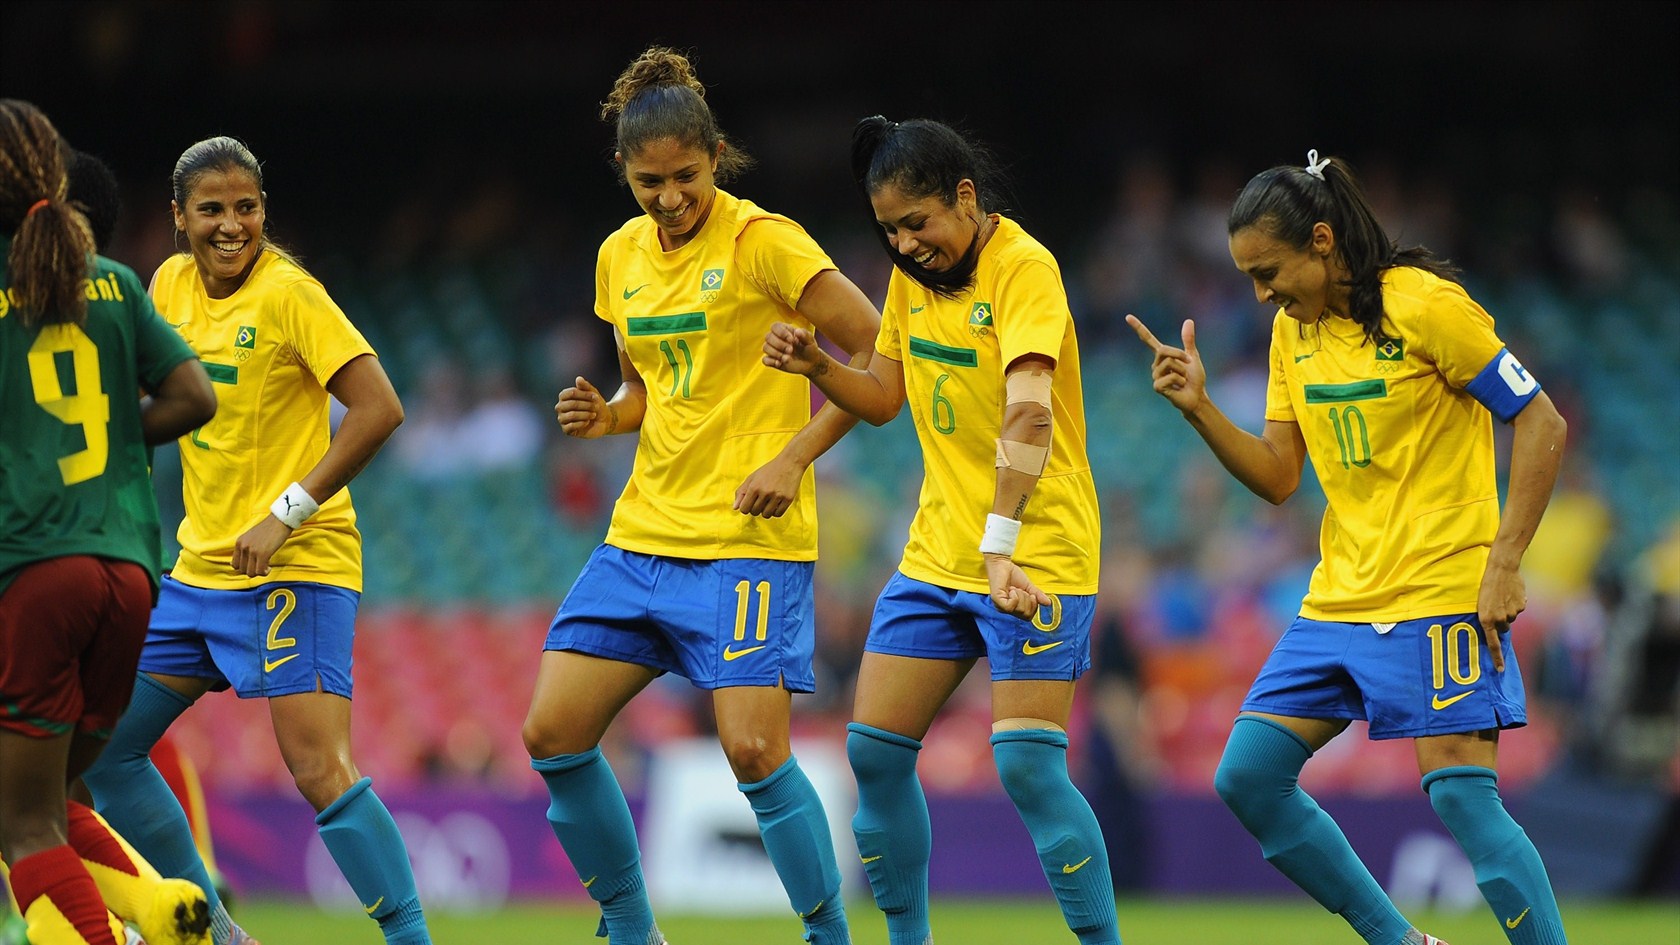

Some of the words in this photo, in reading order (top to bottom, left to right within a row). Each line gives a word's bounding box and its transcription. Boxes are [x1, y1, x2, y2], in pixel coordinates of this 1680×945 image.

[659, 339, 693, 399] 11
[1497, 351, 1538, 397] C
[28, 322, 109, 486] 9
[932, 374, 955, 435] 6
[1328, 405, 1371, 470] 10
[266, 588, 296, 651] 2
[733, 580, 771, 641] 11
[1426, 622, 1481, 690] 10
